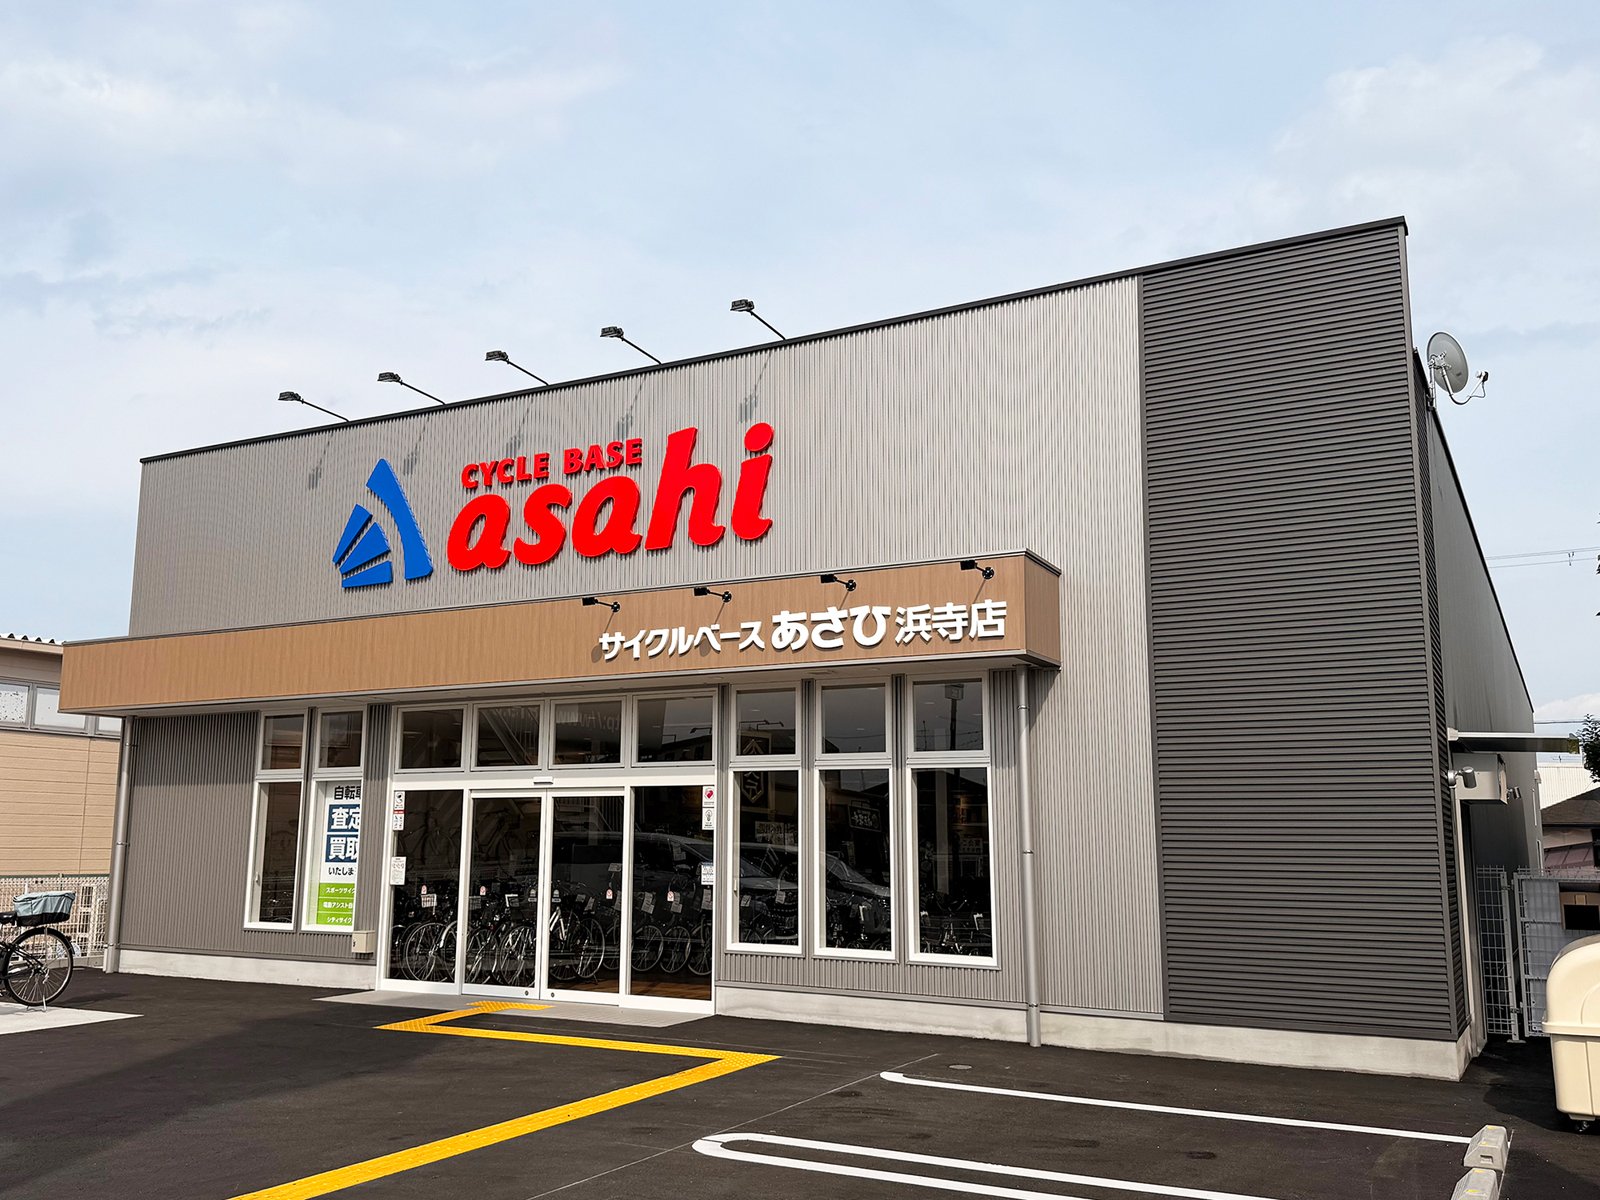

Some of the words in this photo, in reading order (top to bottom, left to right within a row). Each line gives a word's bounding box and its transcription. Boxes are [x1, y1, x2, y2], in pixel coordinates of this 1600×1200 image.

[461, 453, 550, 489] CYCLE
[564, 437, 643, 475] BASE
[446, 422, 775, 572] asahi
[598, 621, 765, 660] サイクルベース
[771, 605, 892, 651] あさひ
[894, 598, 1007, 644] 浜寺店
[331, 806, 360, 830] 査定
[329, 837, 358, 860] 買取
[328, 867, 357, 876] いたしま
